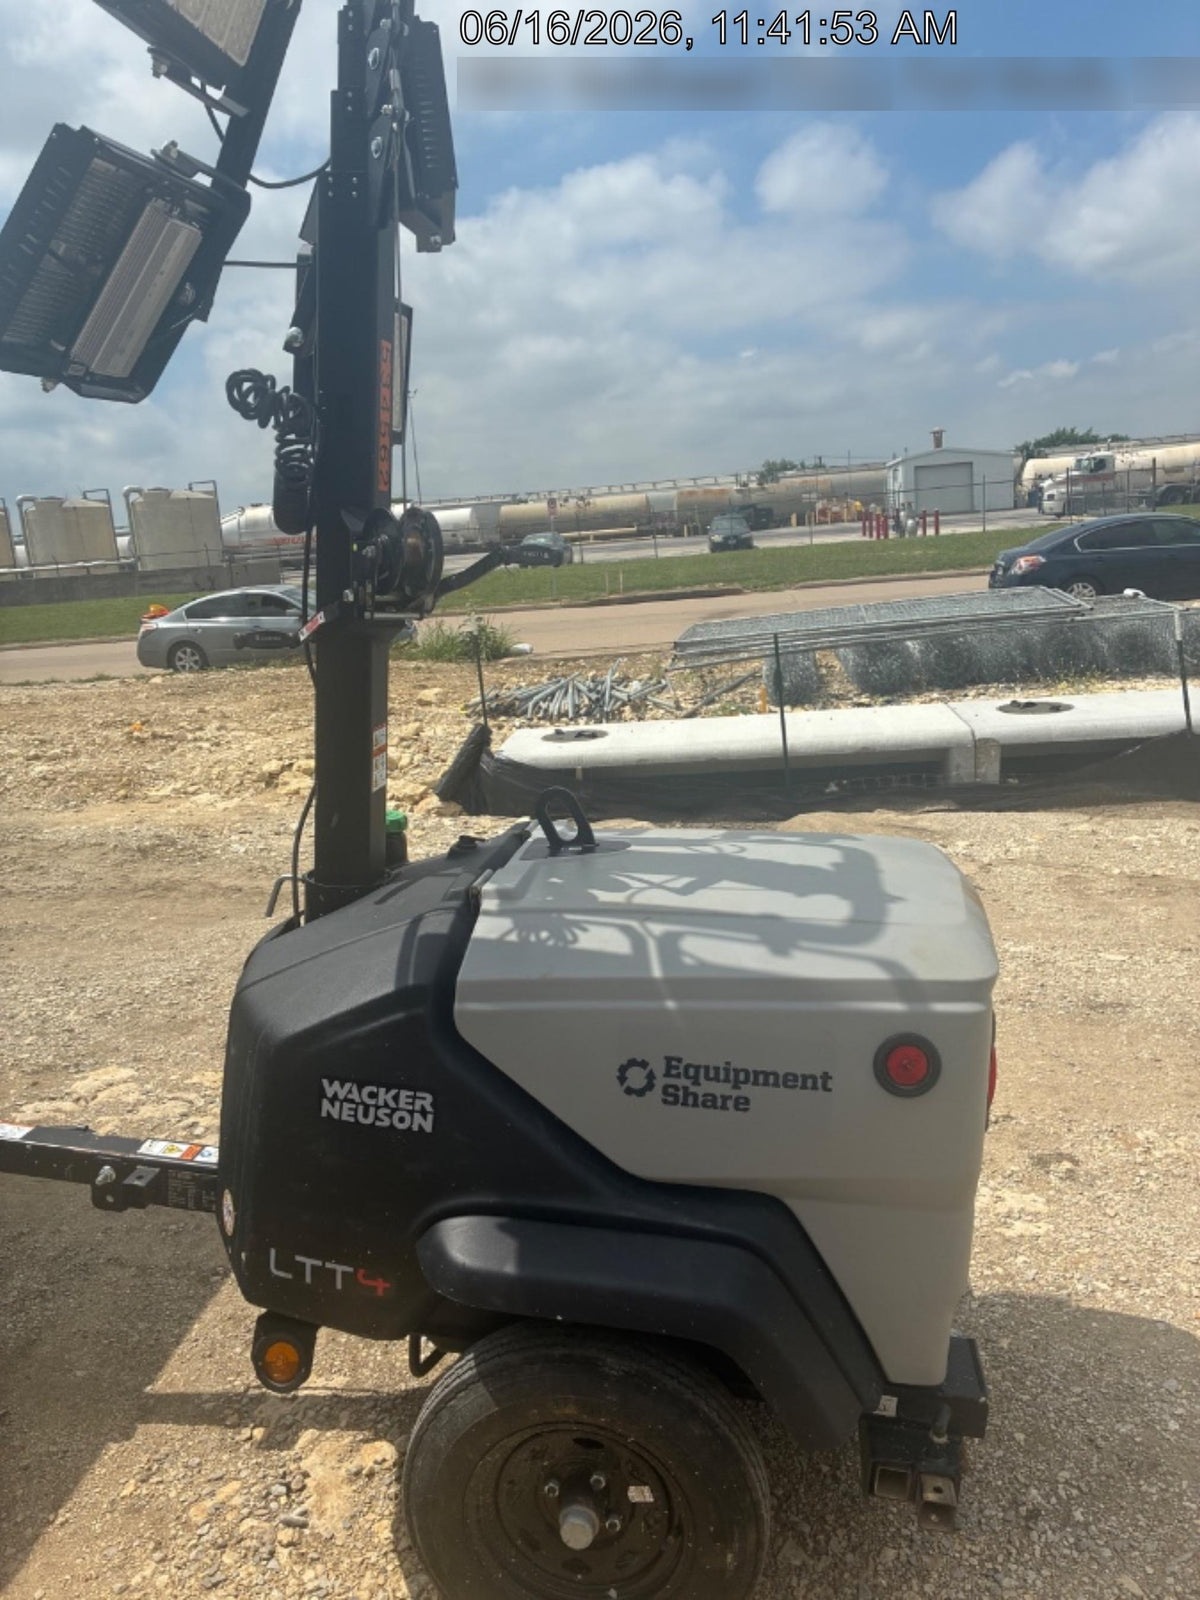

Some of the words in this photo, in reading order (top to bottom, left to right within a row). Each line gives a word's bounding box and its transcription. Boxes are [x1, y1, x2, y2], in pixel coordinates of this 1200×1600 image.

[663, 1056, 833, 1092] Equipment
[321, 1078, 434, 1112] WACKER
[661, 1084, 751, 1112] Share
[321, 1098, 435, 1133] NEUSON
[269, 1247, 391, 1296] LTT4
